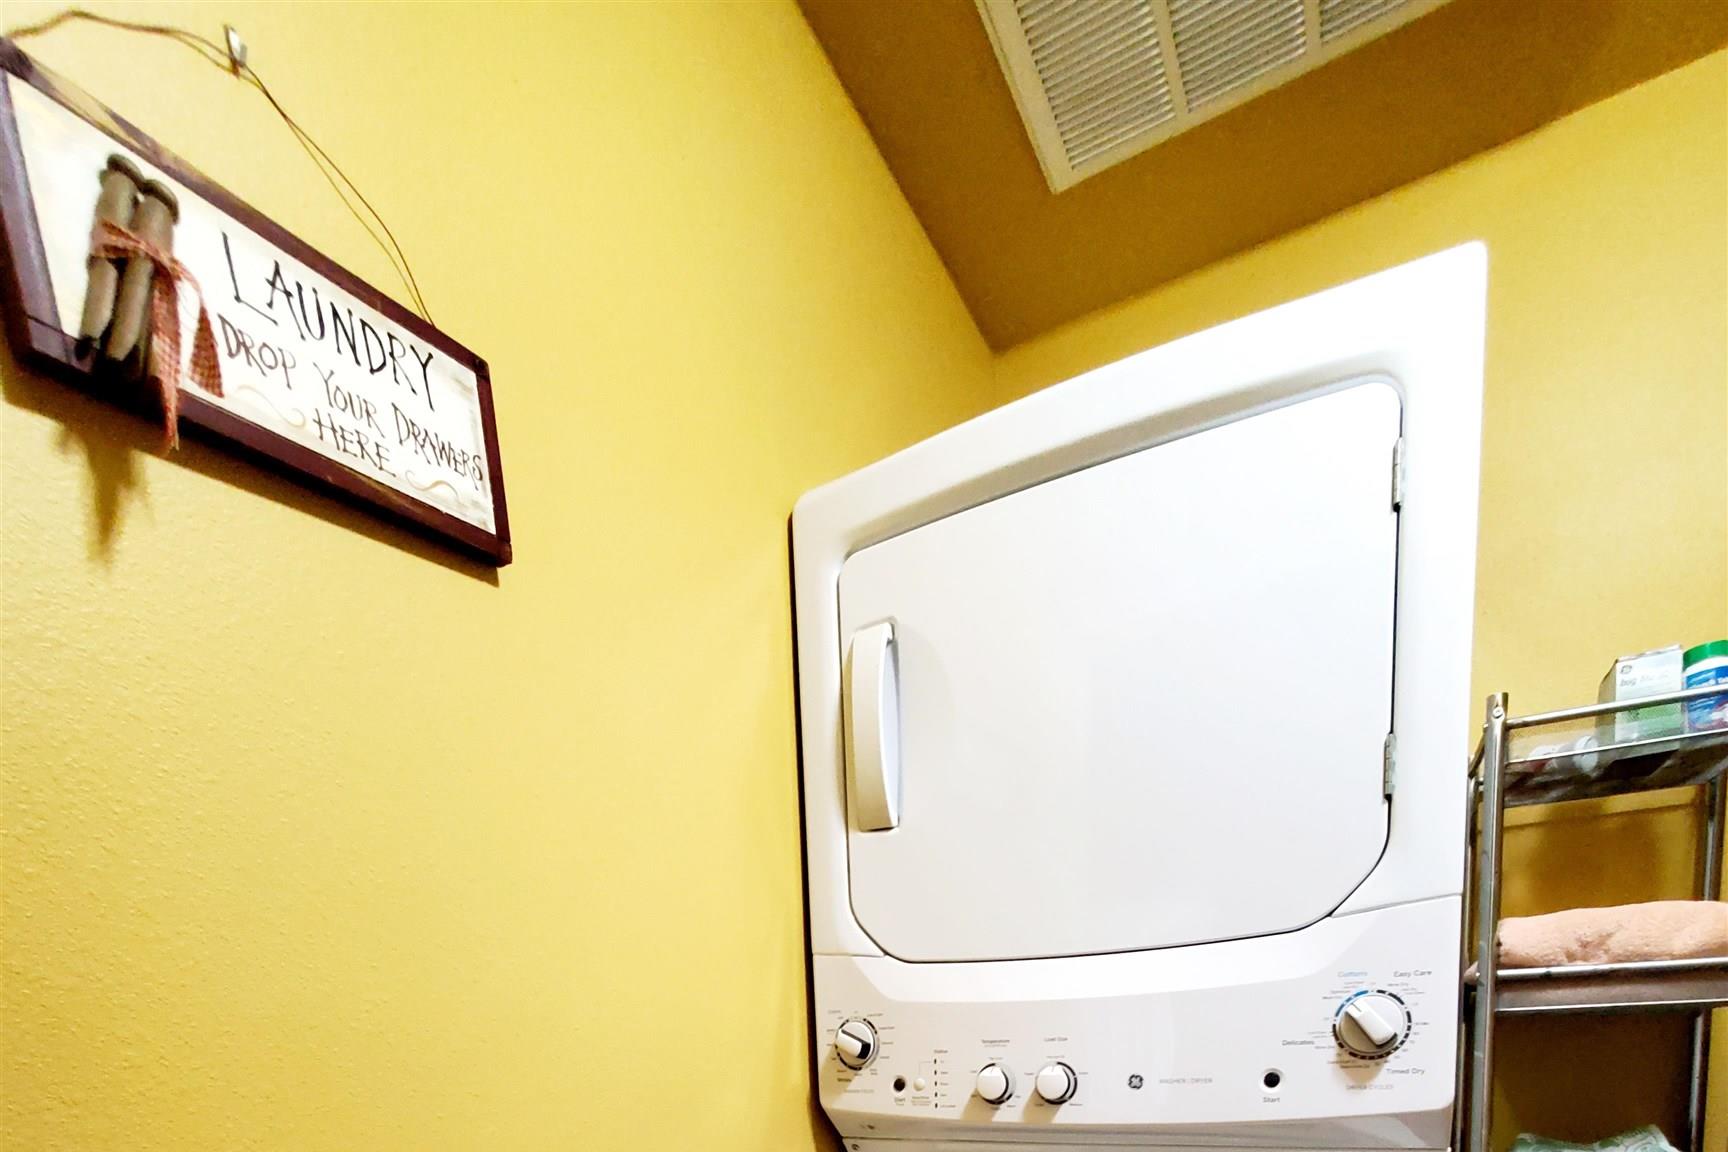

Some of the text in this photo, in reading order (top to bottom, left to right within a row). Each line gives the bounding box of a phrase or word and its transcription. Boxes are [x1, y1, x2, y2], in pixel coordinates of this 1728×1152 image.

[222, 231, 435, 412] LAUNDRY
[217, 312, 484, 491] DROP YOUR DRAWERS
[312, 407, 397, 478] HERE
[1393, 969, 1433, 979] Easy Care
[1386, 1067, 1425, 1076] Timed Dry
